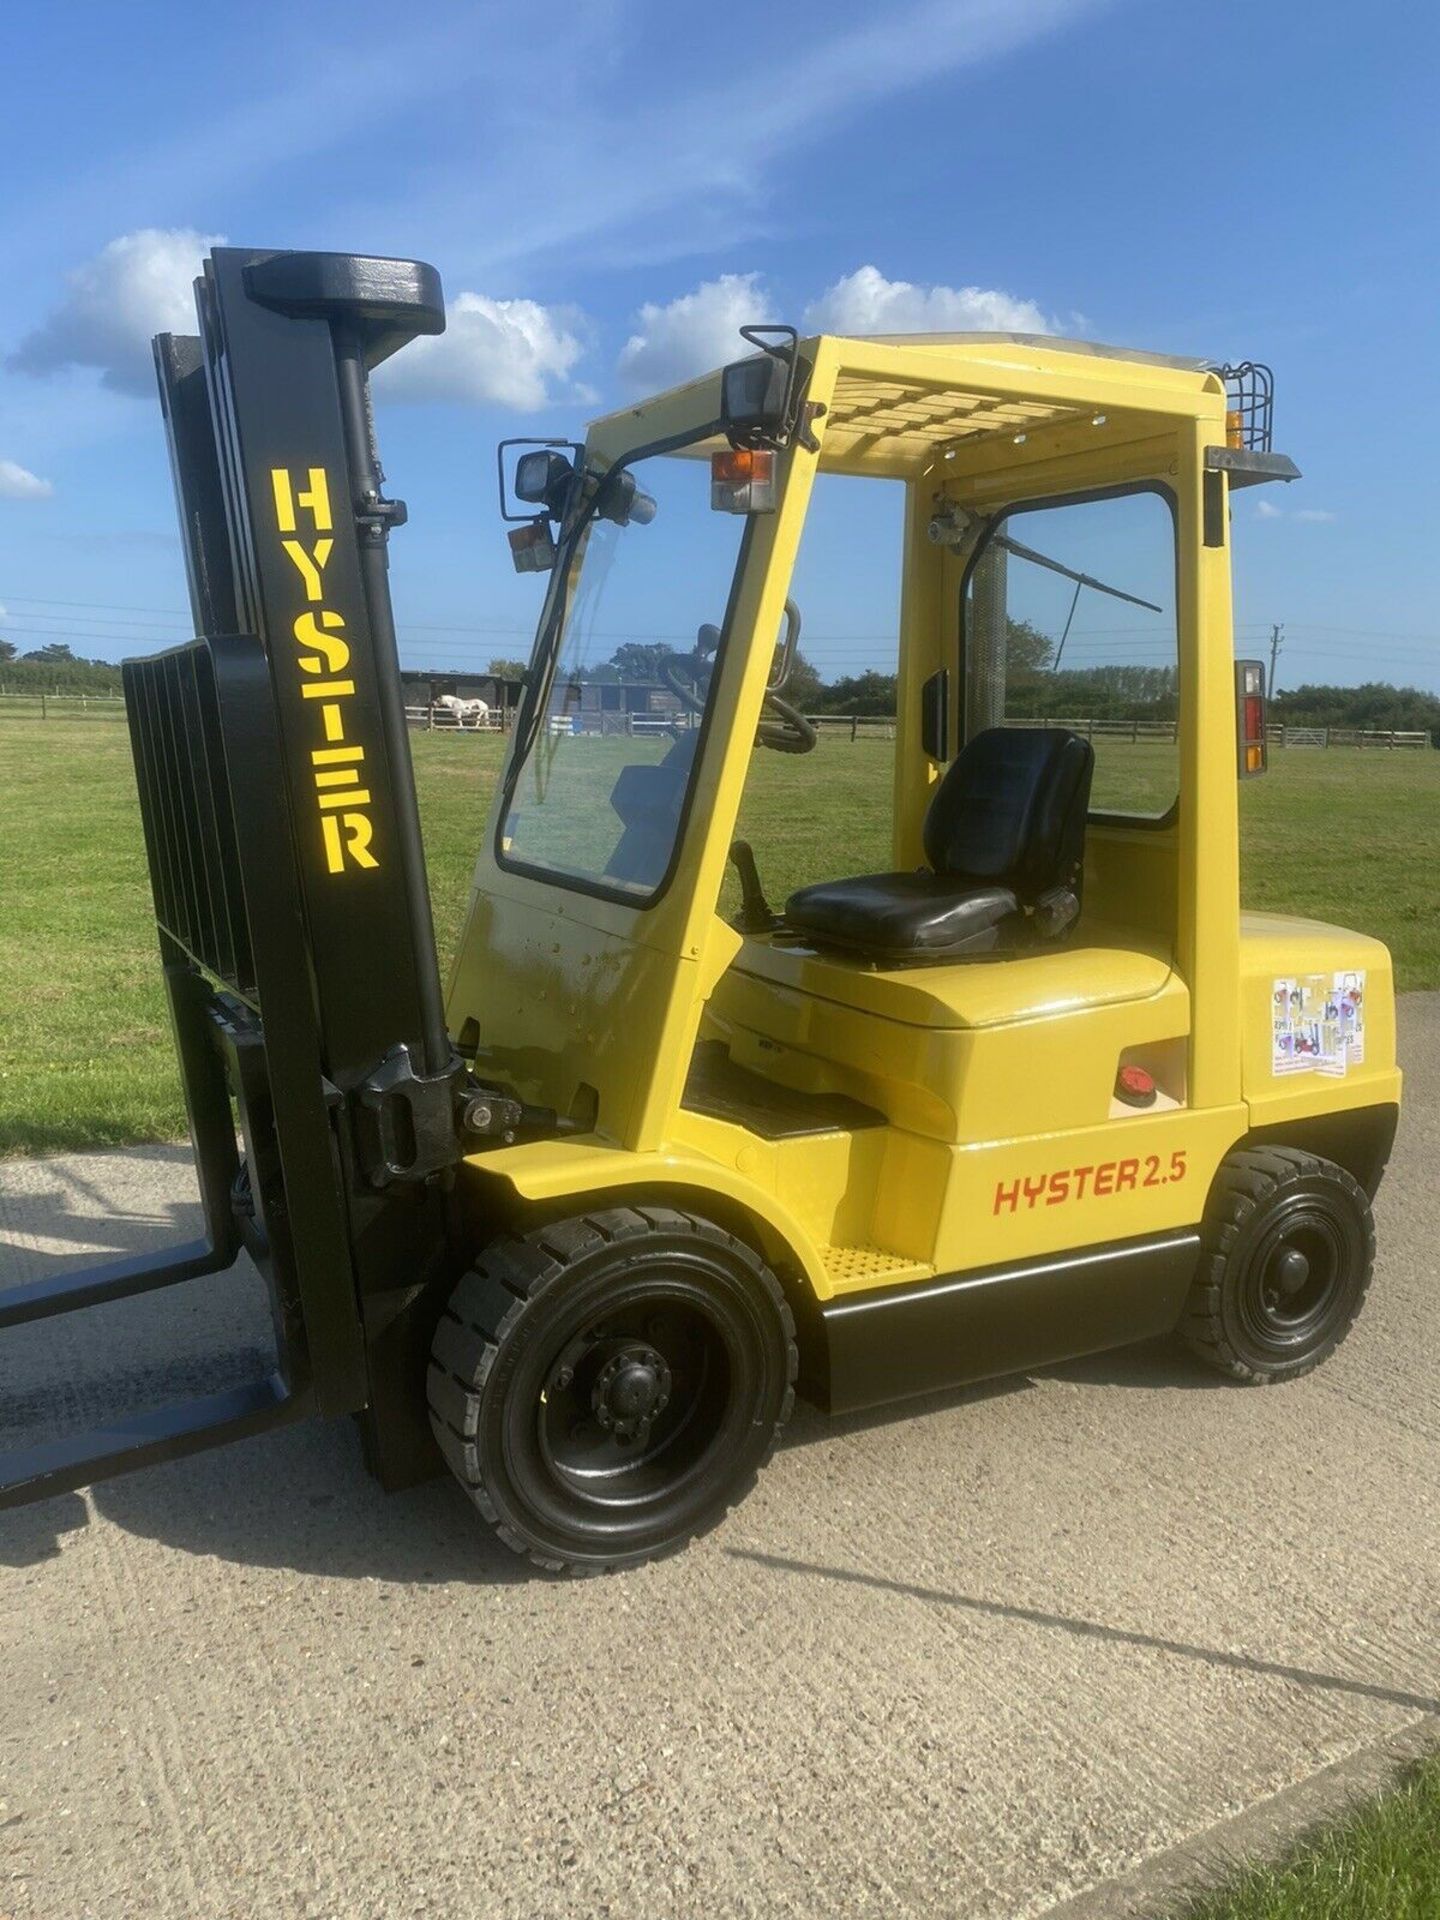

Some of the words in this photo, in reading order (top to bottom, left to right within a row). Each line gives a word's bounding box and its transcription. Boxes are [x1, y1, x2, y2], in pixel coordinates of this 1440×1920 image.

[271, 468, 379, 873] HYSTER
[993, 1158, 1140, 1215] HYSTER
[1142, 1150, 1187, 1187] 2.5
